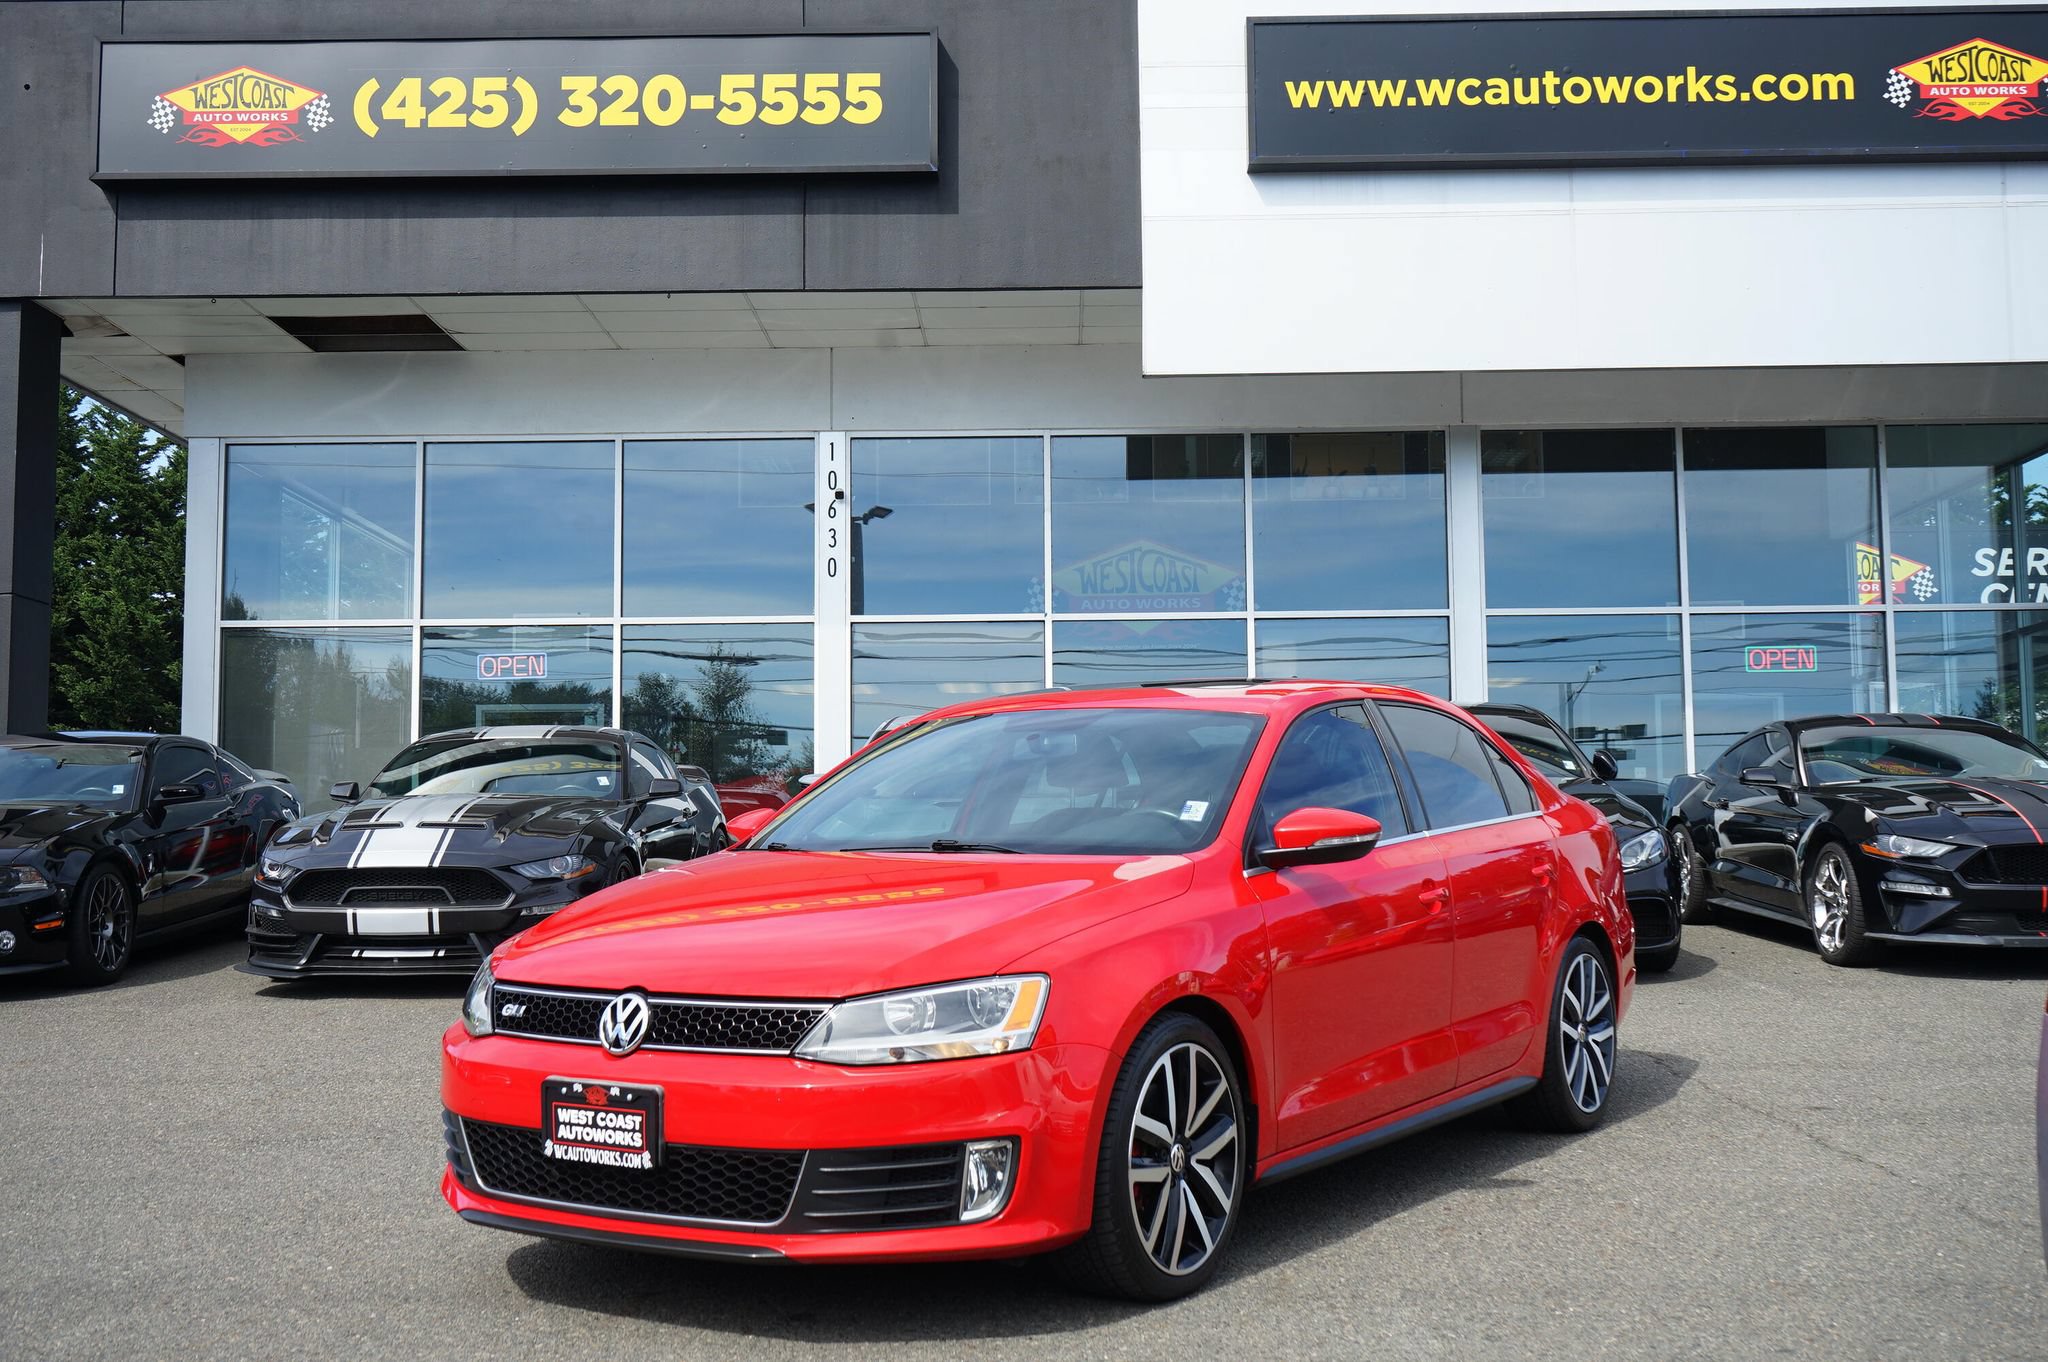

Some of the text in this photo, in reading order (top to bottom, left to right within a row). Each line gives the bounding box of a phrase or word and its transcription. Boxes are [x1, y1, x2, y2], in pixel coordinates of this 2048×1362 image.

[1285, 65, 1855, 108] www.wcautoworks.com
[1929, 86, 2028, 96] AUTO WORKS
[353, 73, 883, 138] (425) 320-5555
[193, 112, 289, 122] AUTO WORKS
[827, 441, 838, 578] 10630
[1081, 598, 1200, 610] AUTO WORKS
[481, 655, 544, 677] OPEN
[1749, 648, 1814, 670] OPEN
[557, 1108, 643, 1131] WEST COAST
[557, 1125, 643, 1147] AUTOWORKS
[554, 1144, 642, 1168] WCAUTOWORKS.COM
